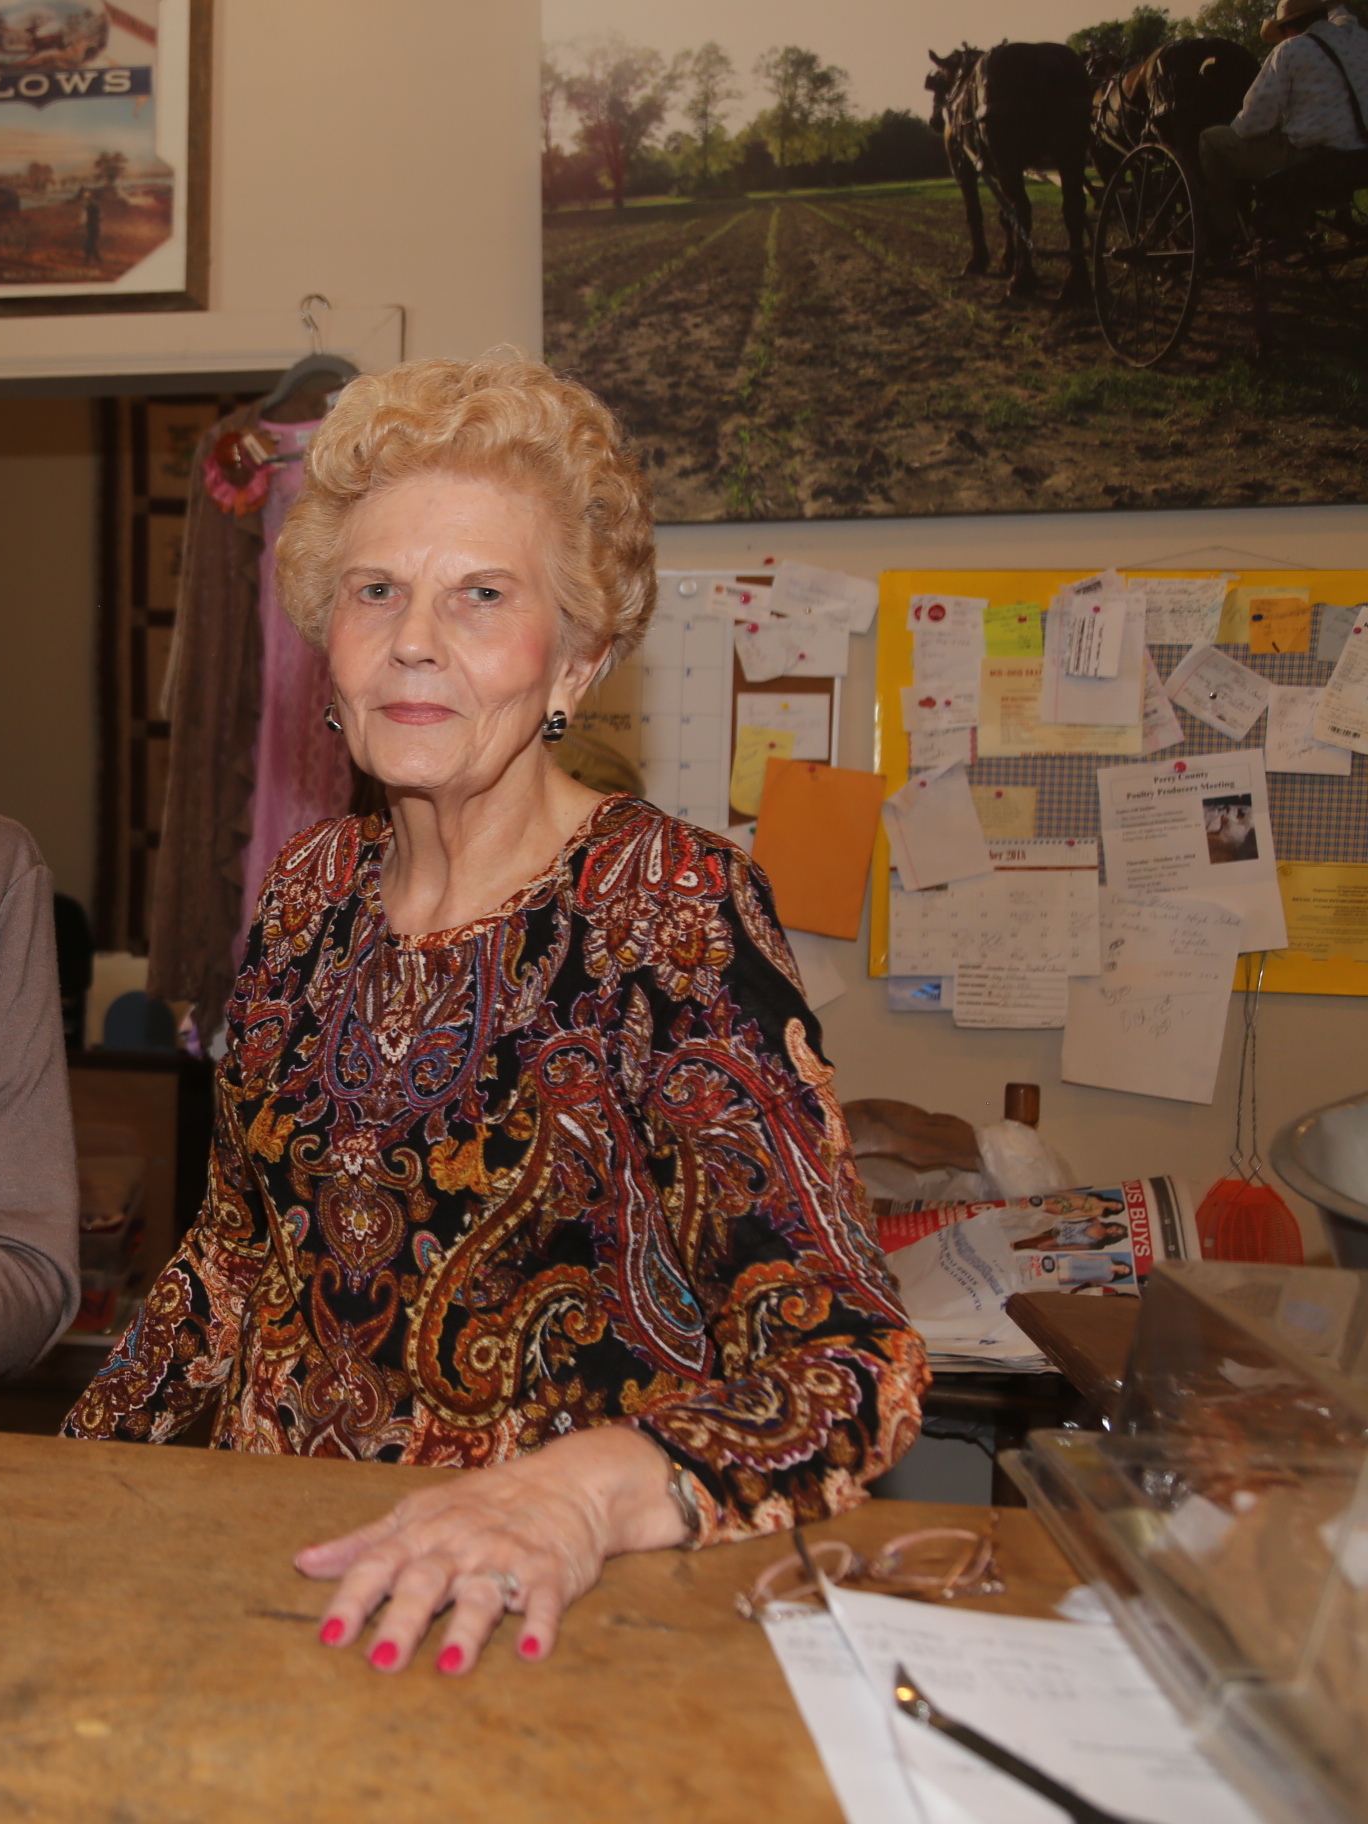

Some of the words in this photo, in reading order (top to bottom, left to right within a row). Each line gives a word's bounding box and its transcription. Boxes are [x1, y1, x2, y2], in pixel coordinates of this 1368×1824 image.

[1153, 774, 1176, 784] Perry
[1178, 771, 1209, 781] County
[1126, 790, 1155, 800] Poultry
[1157, 785, 1199, 796] Producers
[1201, 780, 1236, 791] Meeting
[1129, 1207, 1151, 1257] BUYS
